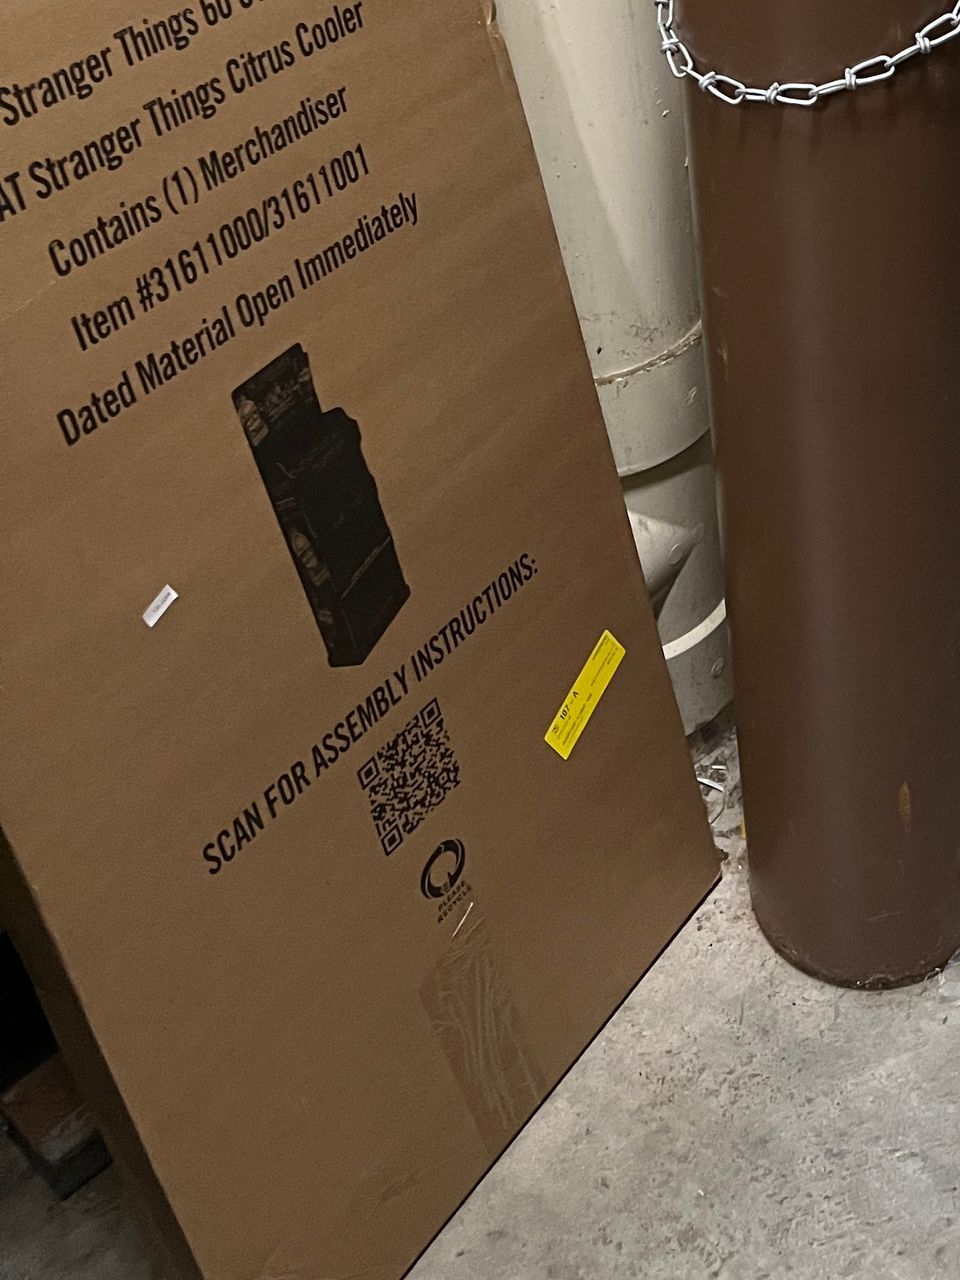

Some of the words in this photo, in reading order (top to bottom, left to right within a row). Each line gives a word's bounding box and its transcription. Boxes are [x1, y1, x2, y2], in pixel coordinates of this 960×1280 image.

[0, 45, 114, 122] Stranger
[113, 6, 199, 68] Things
[28, 117, 143, 200] Stranger
[143, 76, 227, 137] Things
[226, 38, 296, 95] Citrus
[296, 1, 365, 52] Cooler
[47, 193, 163, 278] Contains
[162, 165, 200, 215] (1)
[198, 85, 349, 192] Merchandiser
[70, 292, 136, 352] Item
[135, 142, 370, 313] #31611000/31611001
[56, 370, 138, 447] Dated
[134, 305, 236, 395] Material
[235, 273, 297, 329] Open
[294, 190, 420, 290] Immediately
[202, 800, 266, 875] SCAN
[263, 759, 311, 820] FOR
[310, 668, 412, 779] ASSEMBLY
[410, 551, 539, 683] INSTRUCTIONS:
